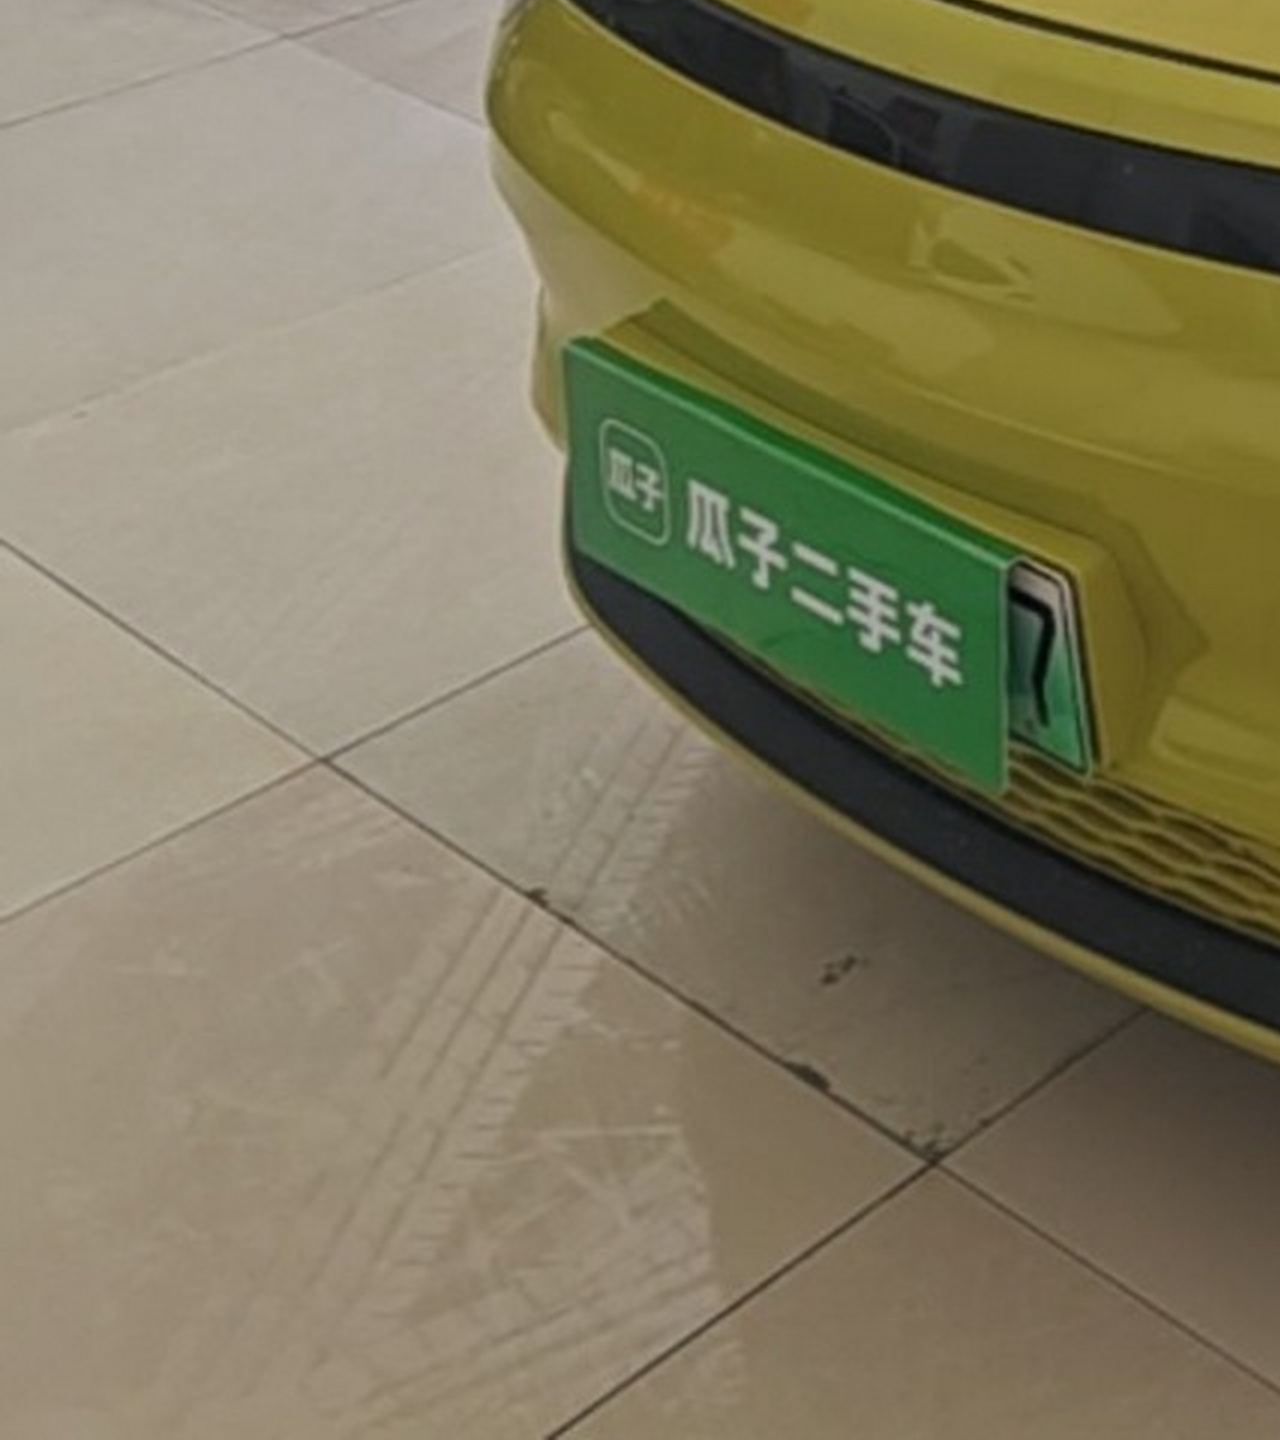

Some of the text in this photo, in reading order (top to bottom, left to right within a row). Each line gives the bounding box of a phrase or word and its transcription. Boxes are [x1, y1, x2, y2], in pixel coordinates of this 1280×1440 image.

[608, 447, 665, 513] 瓜子
[686, 478, 963, 687] 瓜子二手车
